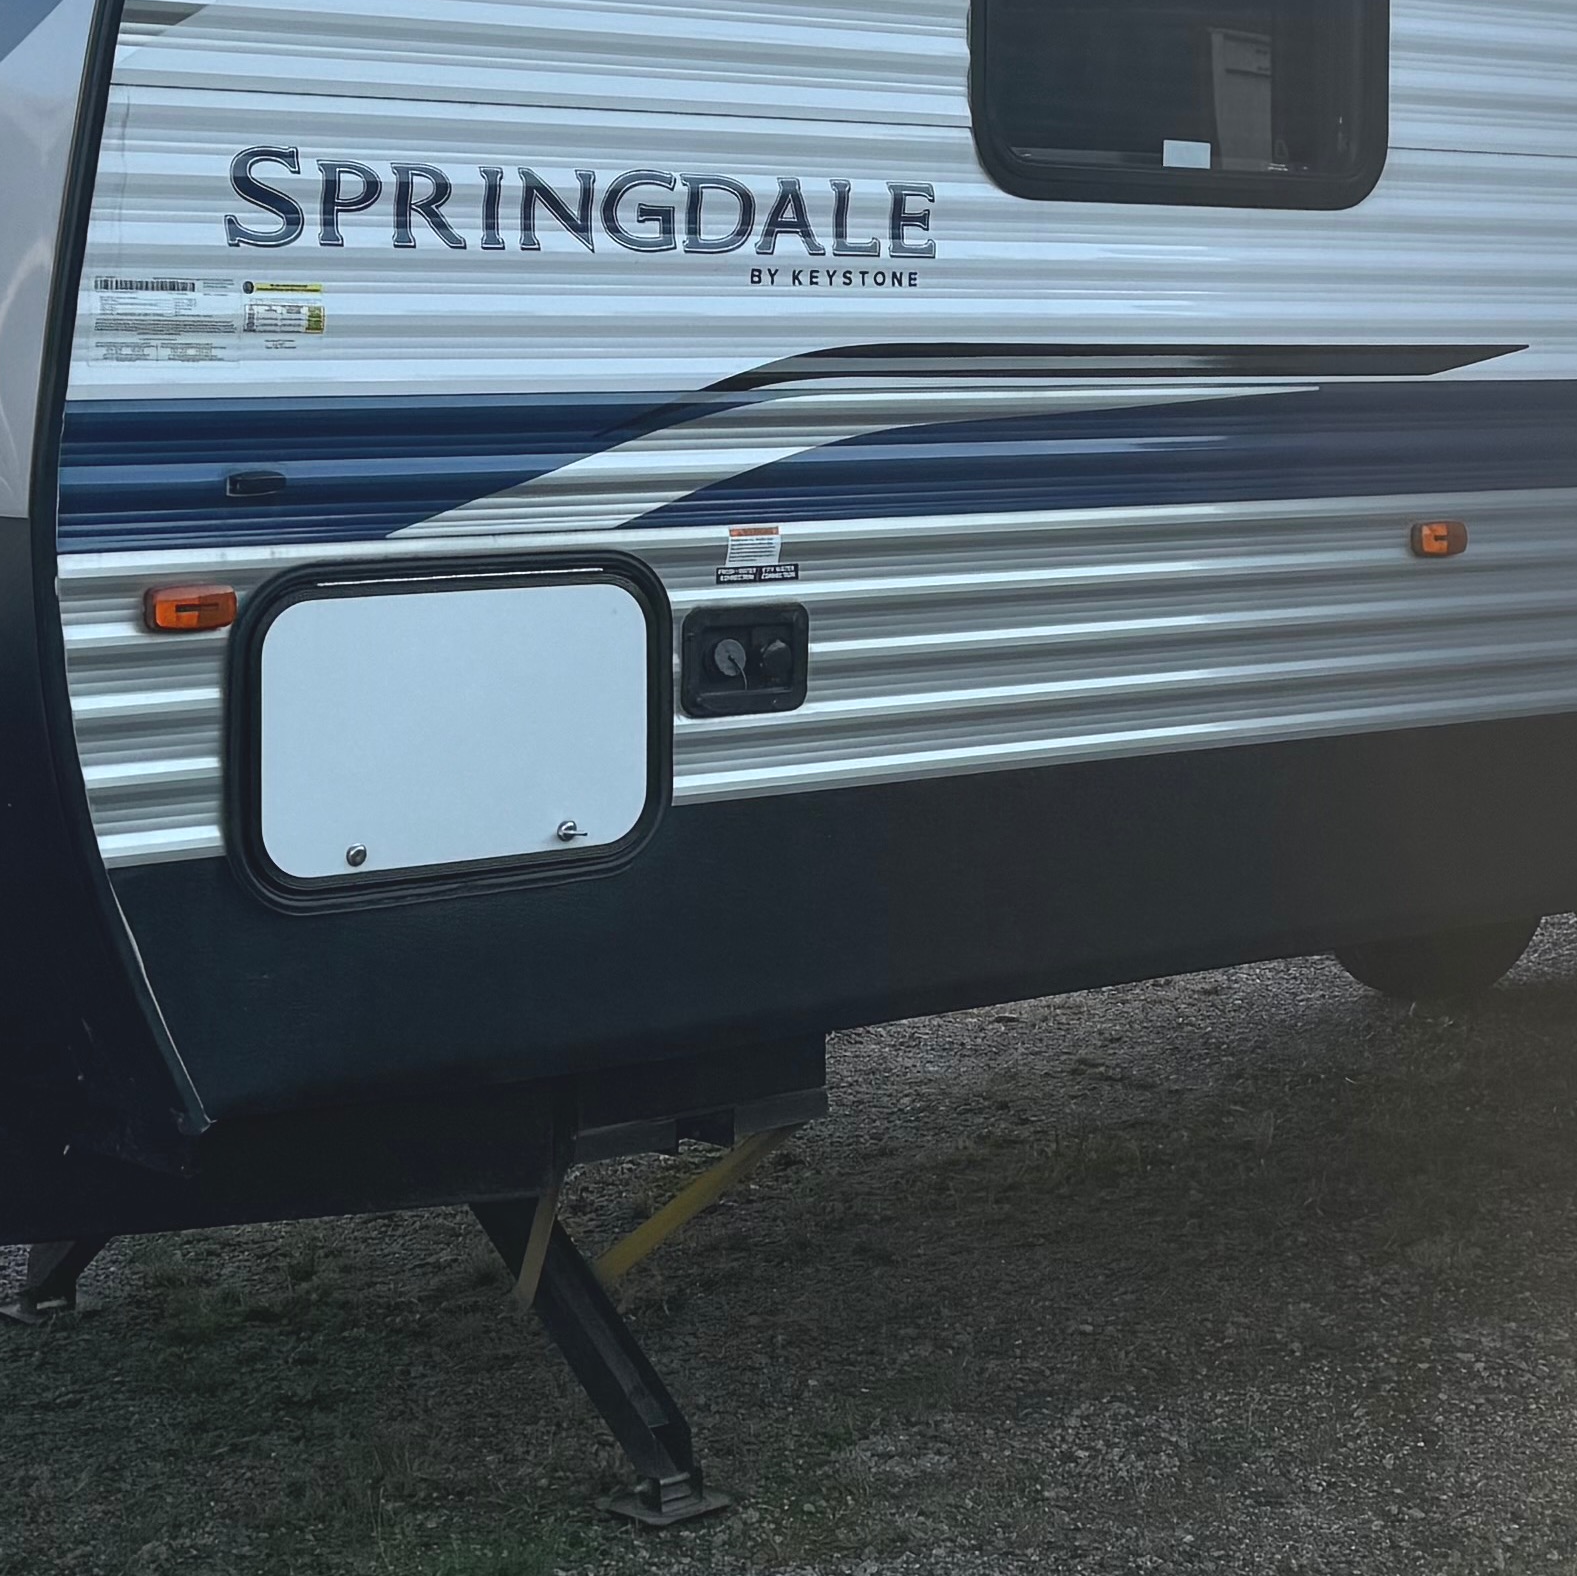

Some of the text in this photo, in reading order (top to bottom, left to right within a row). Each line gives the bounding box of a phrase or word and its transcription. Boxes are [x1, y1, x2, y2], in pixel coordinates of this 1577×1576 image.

[224, 145, 937, 259] SPRINGDALE
[750, 268, 918, 288] BY KEYSTONE
